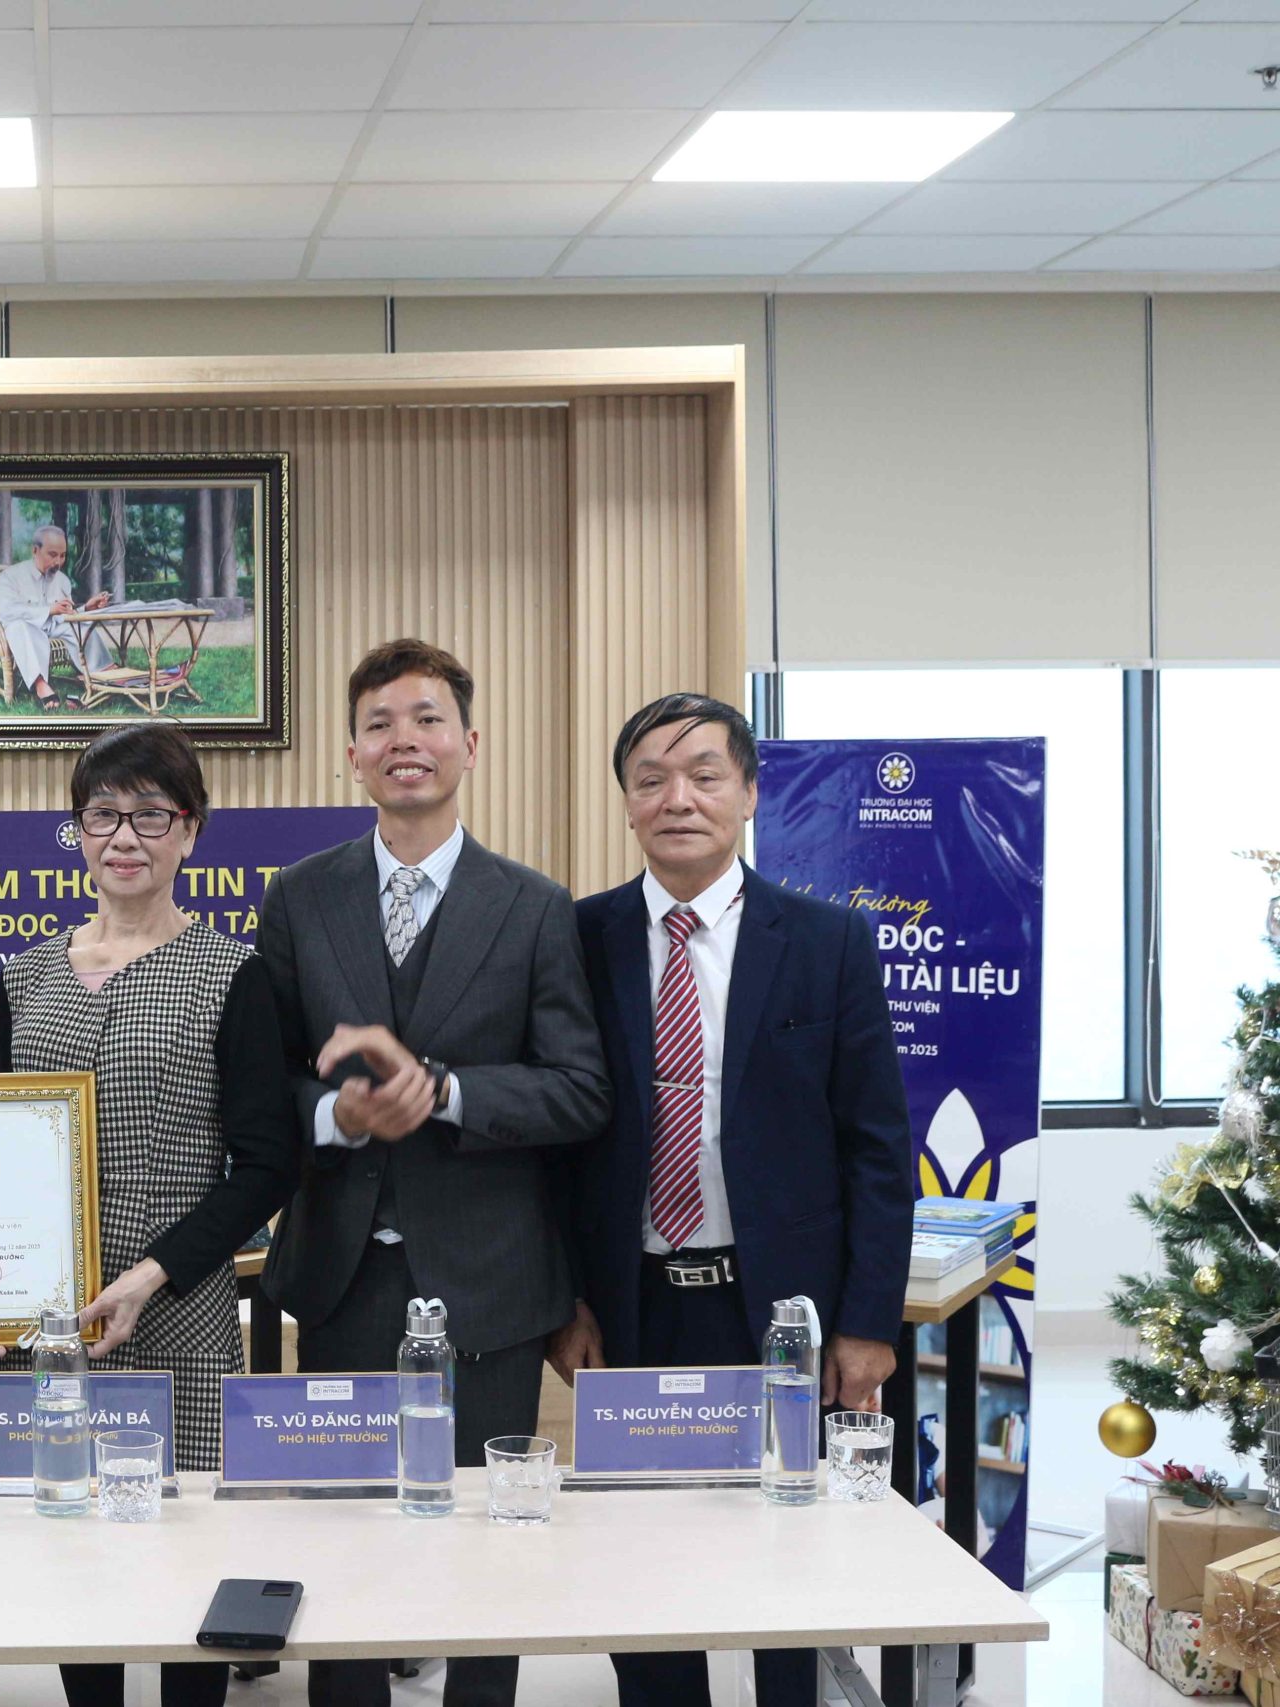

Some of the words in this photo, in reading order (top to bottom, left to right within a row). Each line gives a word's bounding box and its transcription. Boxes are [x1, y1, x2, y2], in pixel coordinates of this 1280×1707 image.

[859, 808, 933, 822] INTRACOM
[181, 867, 245, 897] TIN
[876, 924, 944, 957] ĐỌC
[895, 958, 942, 992] TÀI
[951, 961, 1020, 1000] LIỆU
[887, 1000, 912, 1012] THƯ
[913, 1000, 940, 1015] VIỆN
[910, 1043, 938, 1056] 2025
[88, 1408, 121, 1425] VĂN
[126, 1408, 151, 1425] BÁ
[253, 1415, 278, 1428] TS.
[282, 1412, 307, 1428] VŨ
[311, 1411, 361, 1427] ĐĂNG
[366, 1413, 398, 1426] MIN
[593, 1408, 618, 1421] TS.
[623, 1402, 693, 1421] NGUYỄN
[697, 1402, 747, 1422] QUỐC
[8, 1430, 33, 1441] PHÓ
[278, 1432, 304, 1444] PHÓ
[307, 1432, 335, 1445] HIỆU
[338, 1431, 388, 1443] TRƯỞNG
[629, 1424, 655, 1436] PHÓ
[657, 1424, 686, 1437] HIỆU
[689, 1423, 739, 1435] TRƯỞNG
